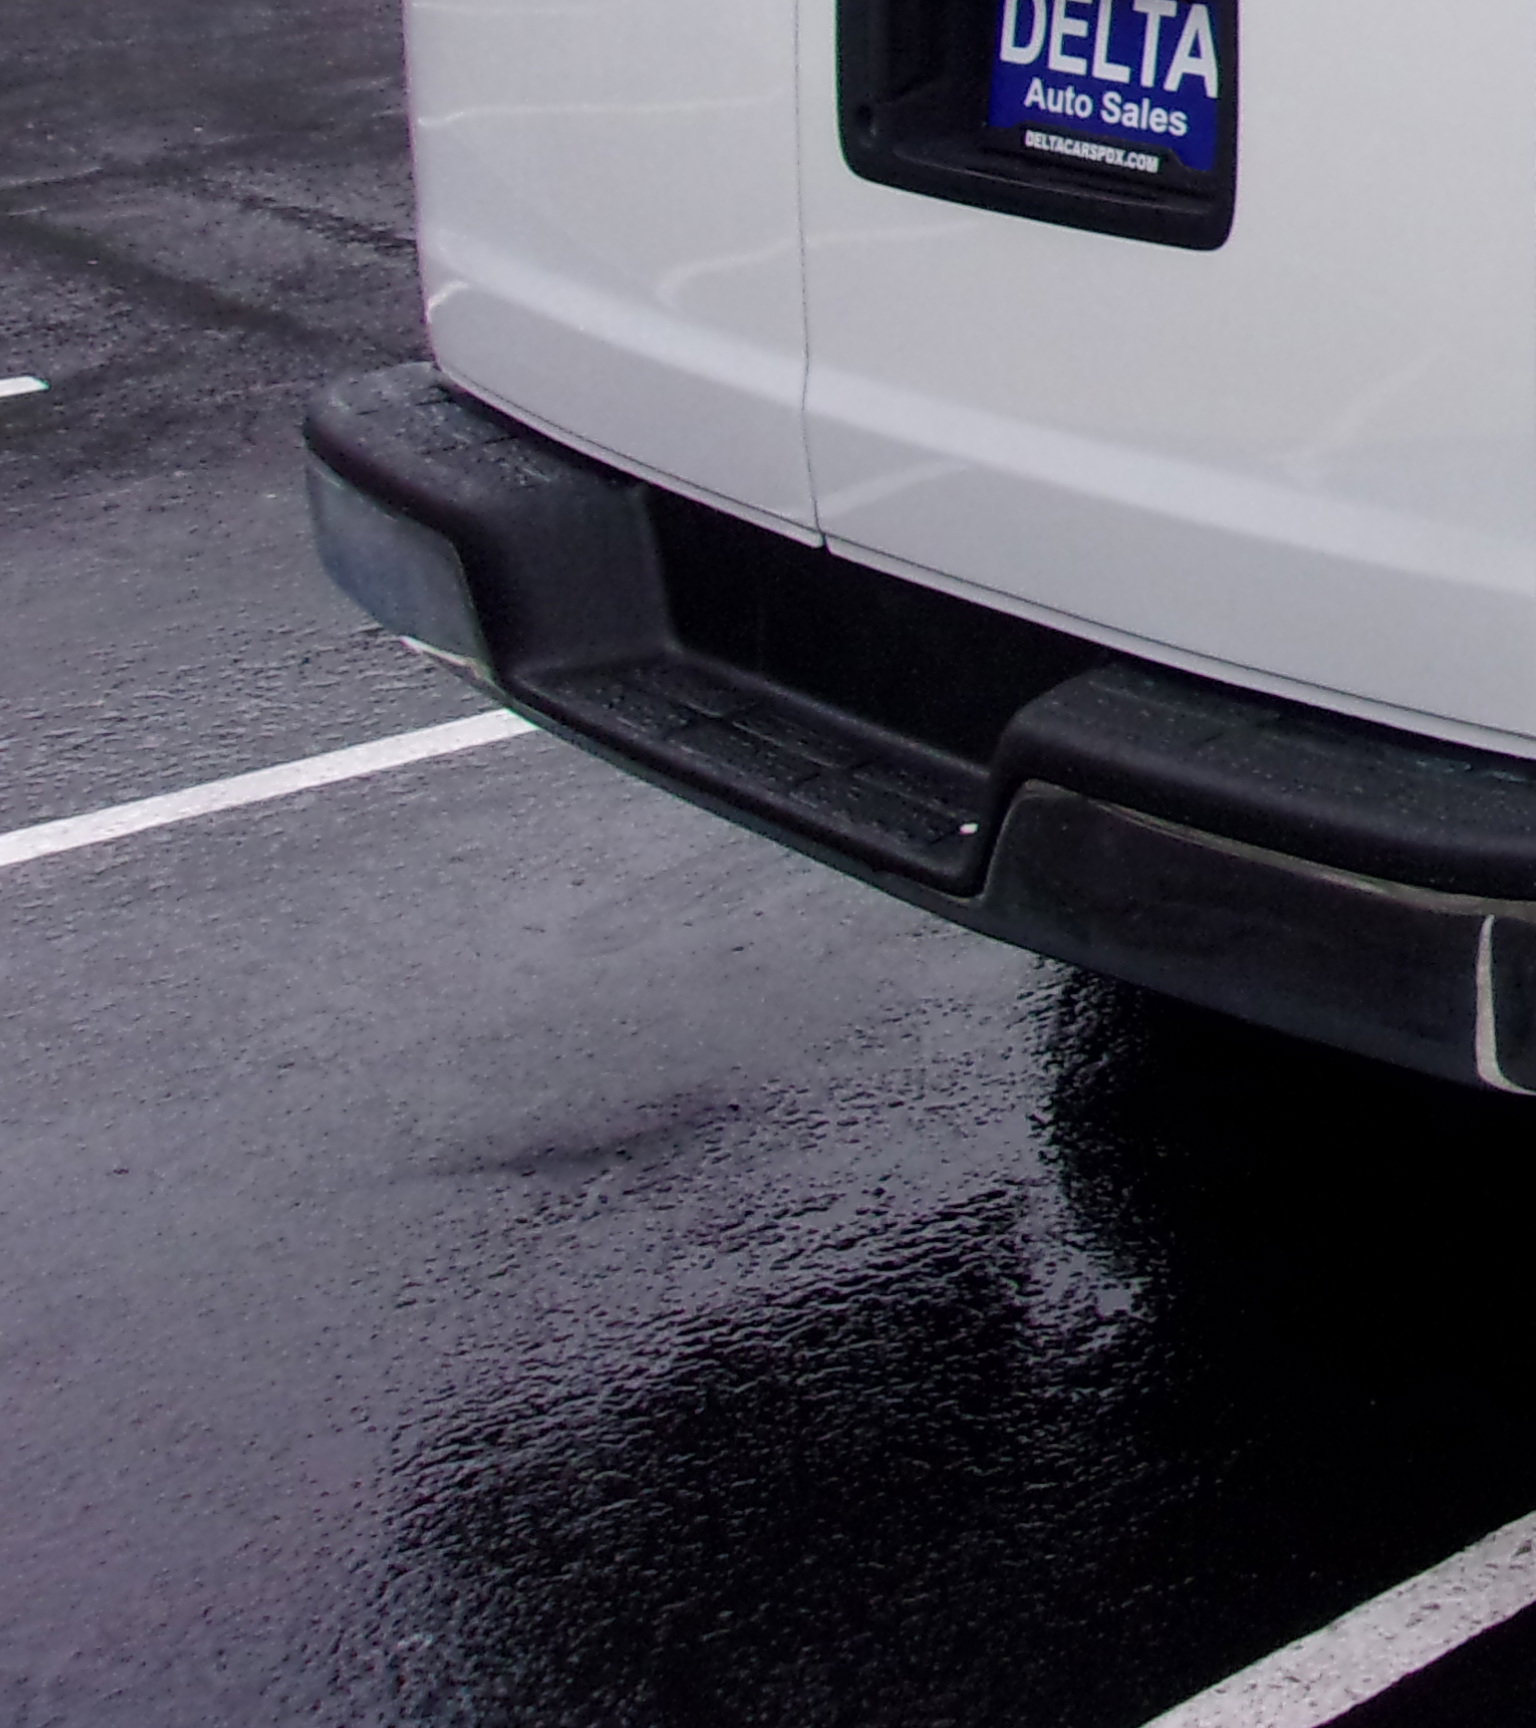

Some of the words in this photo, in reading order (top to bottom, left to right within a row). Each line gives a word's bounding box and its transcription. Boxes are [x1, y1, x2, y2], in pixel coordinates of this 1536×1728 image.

[1024, 77, 1093, 119] Auto
[1101, 91, 1188, 137] Sales
[1024, 129, 1160, 173] DELTACARSPDX.COM
